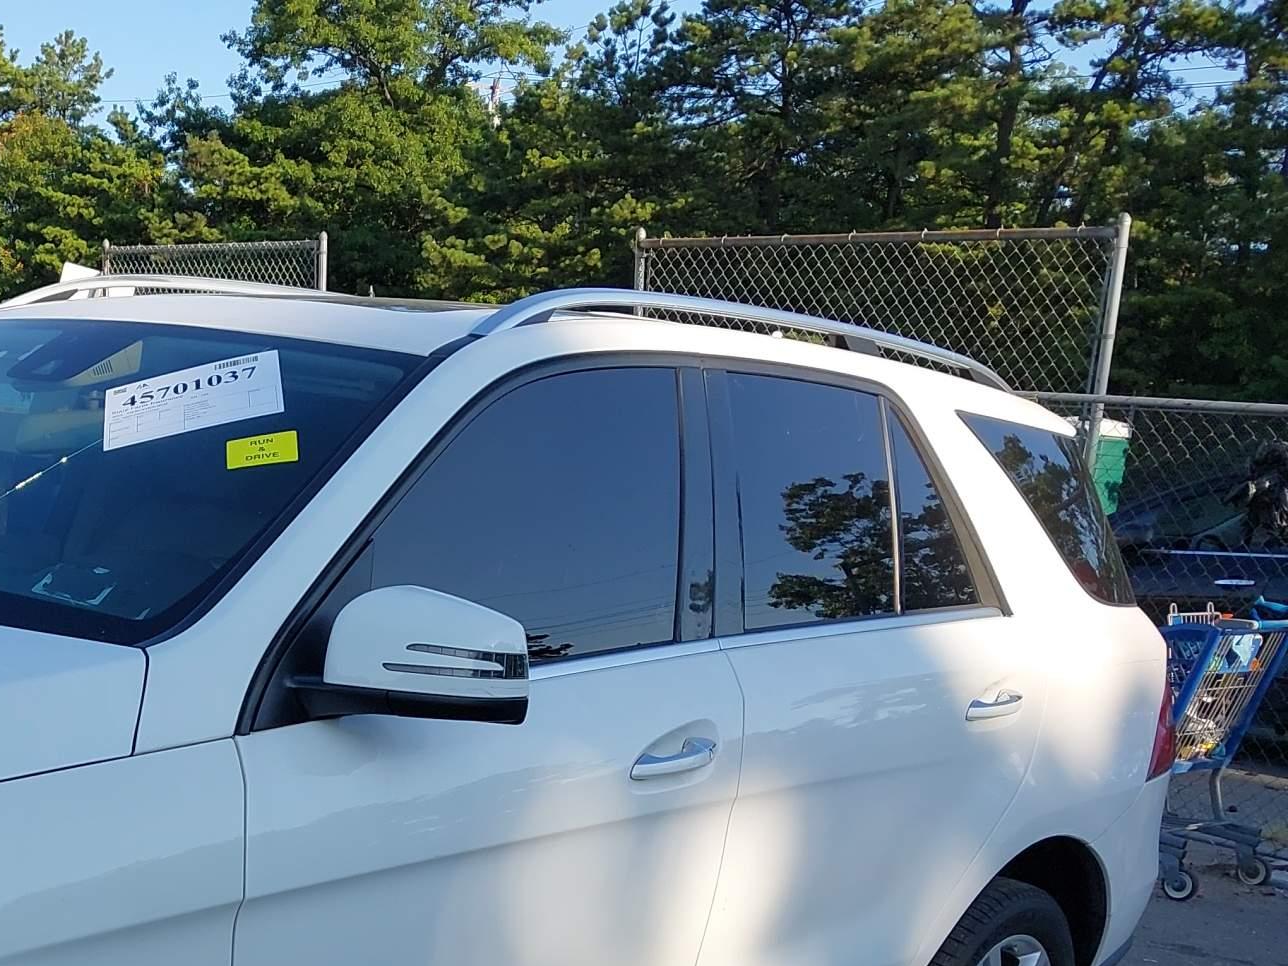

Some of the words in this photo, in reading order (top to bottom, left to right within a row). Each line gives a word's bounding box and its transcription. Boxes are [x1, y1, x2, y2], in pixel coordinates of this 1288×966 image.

[122, 366, 257, 407] 45701037
[249, 438, 274, 446] RUN
[245, 452, 280, 461] DRIVE
